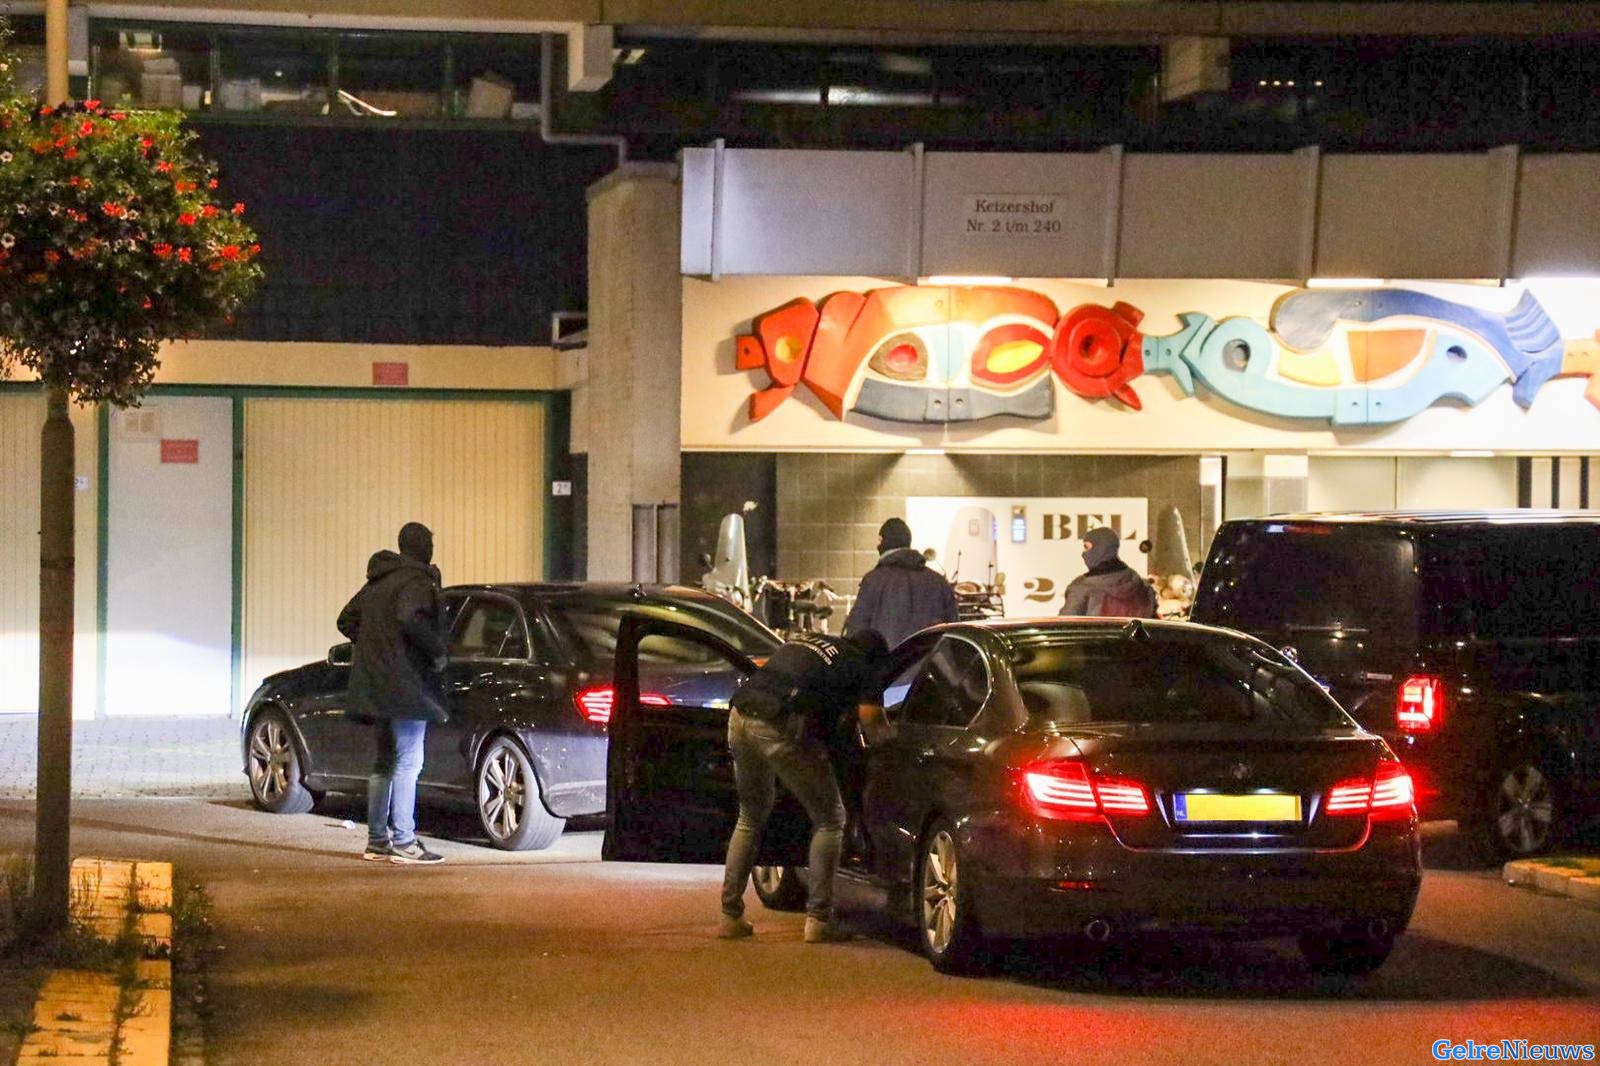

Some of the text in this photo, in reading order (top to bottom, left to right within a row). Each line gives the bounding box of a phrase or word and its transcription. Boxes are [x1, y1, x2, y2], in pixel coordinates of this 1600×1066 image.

[975, 198, 1055, 213] Keizershof
[966, 219, 1062, 234] Nr. 2 t/m 240
[1042, 513, 1137, 541] BEL
[1023, 576, 1057, 603] 2
